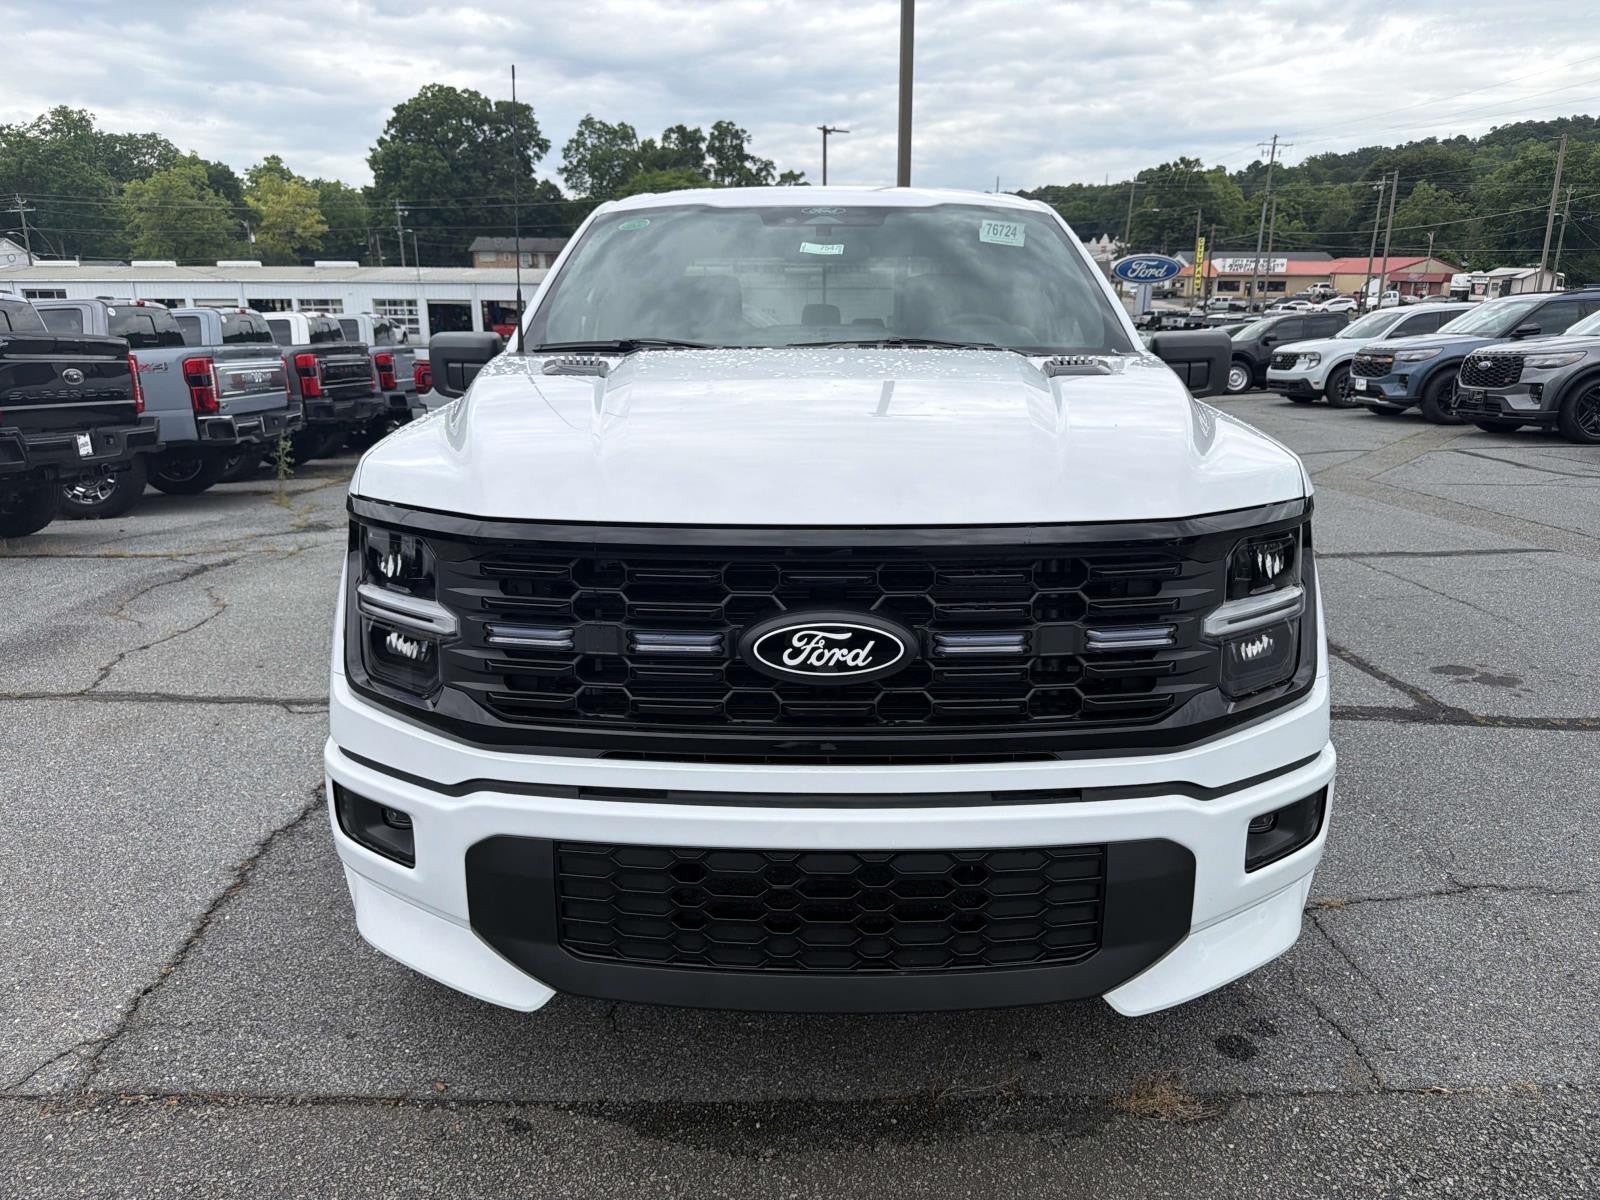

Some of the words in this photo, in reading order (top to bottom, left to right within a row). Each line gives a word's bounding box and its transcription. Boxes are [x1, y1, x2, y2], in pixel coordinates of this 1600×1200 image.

[986, 223, 1017, 239] 76724
[1127, 260, 1168, 277] Ford
[9, 388, 82, 400] SUPER
[782, 630, 875, 667] Ford
